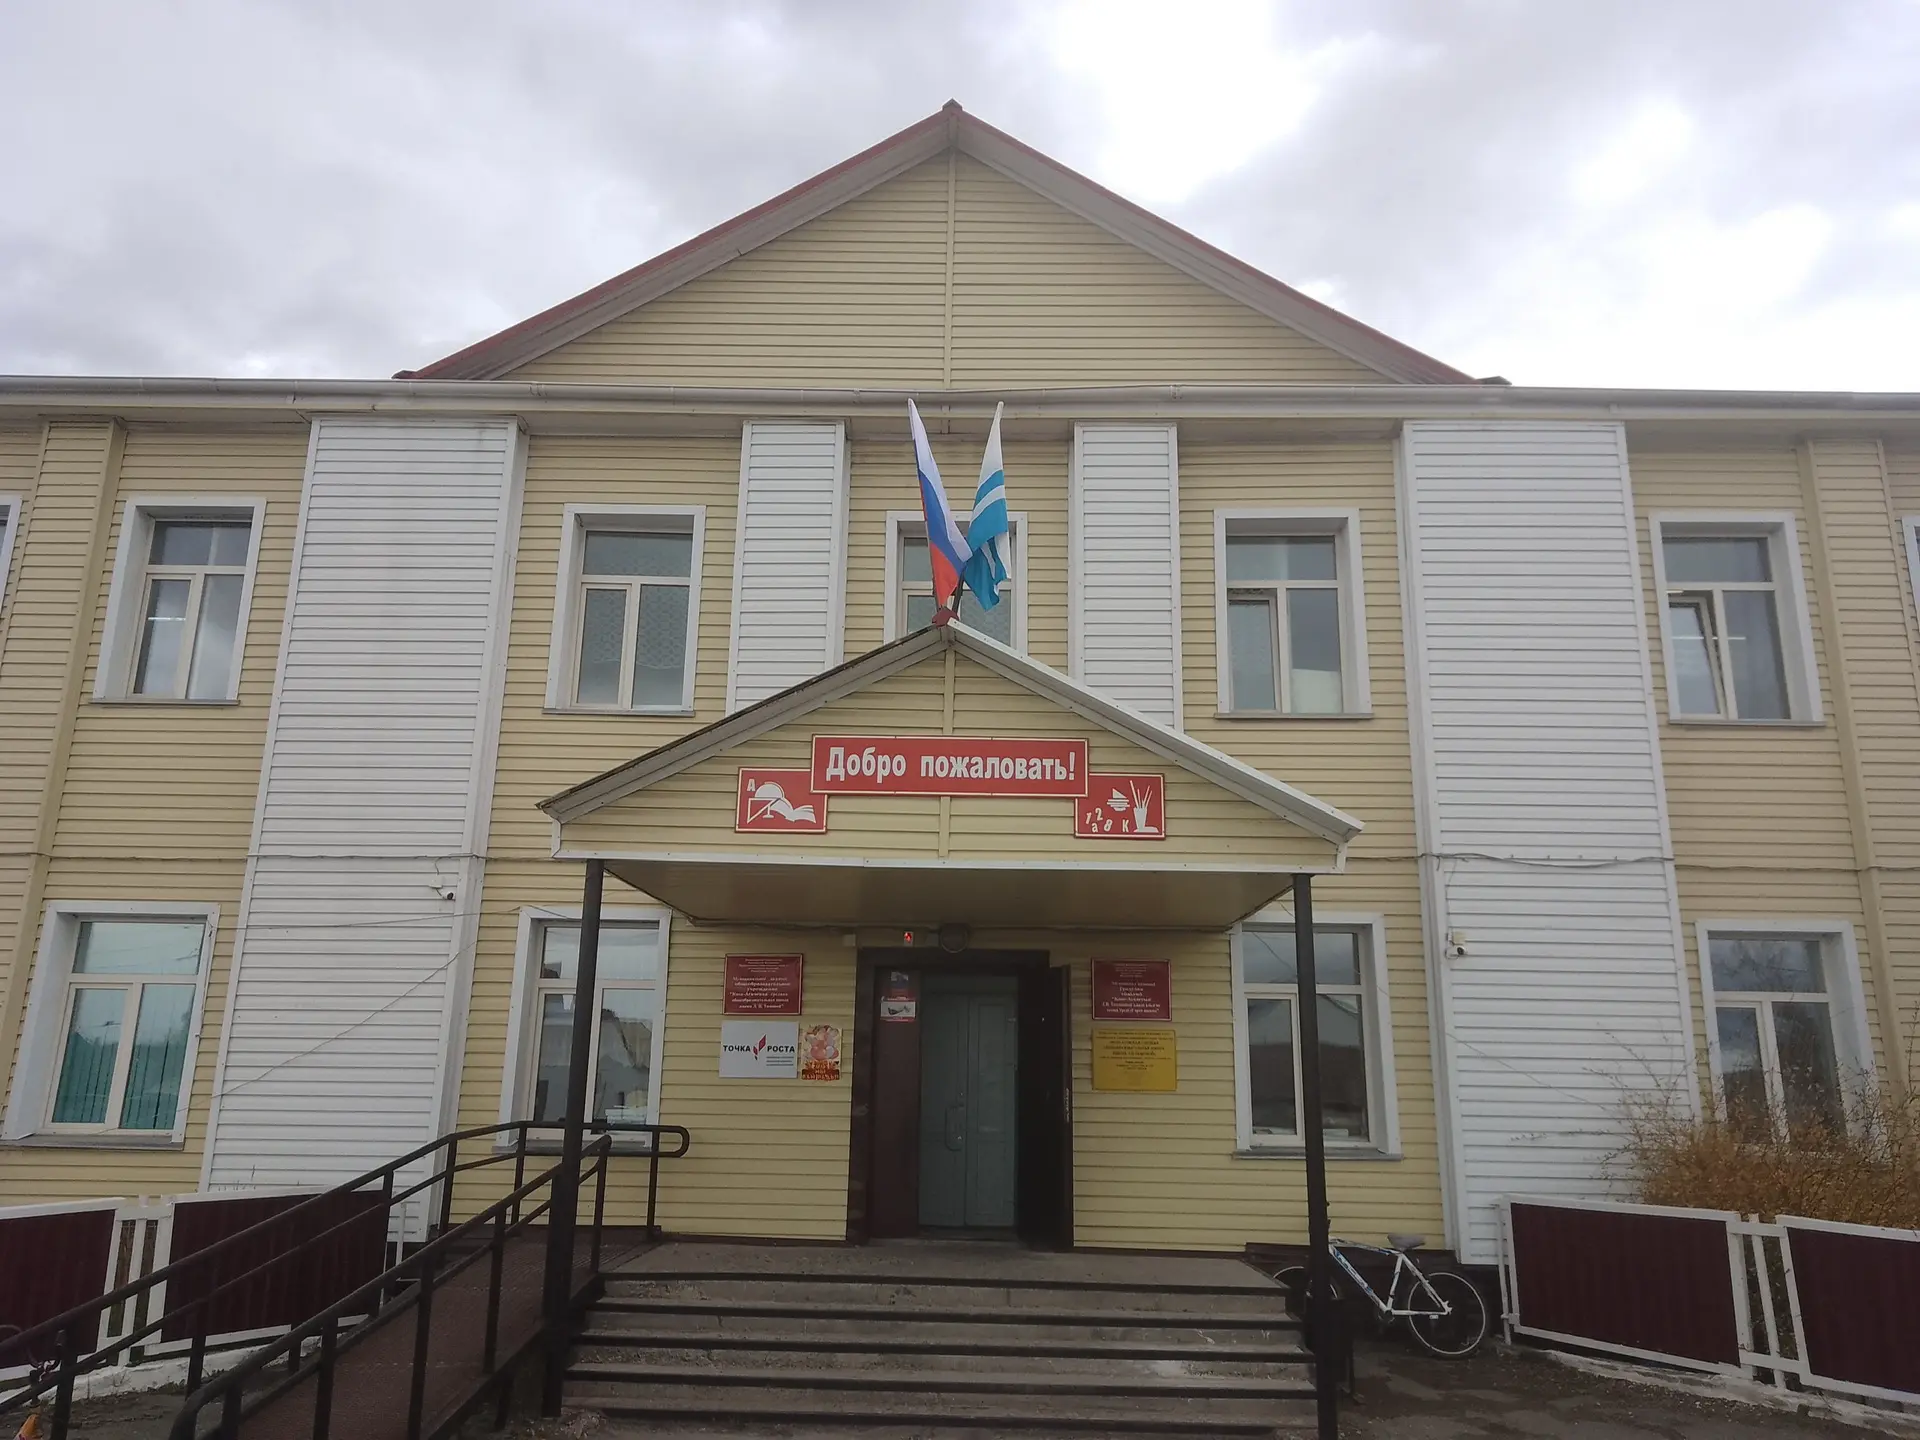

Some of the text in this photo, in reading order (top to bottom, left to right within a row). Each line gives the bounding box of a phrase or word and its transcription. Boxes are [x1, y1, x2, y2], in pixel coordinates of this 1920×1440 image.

[826, 746, 1076, 784] Добро пожаловать!
[767, 1045, 795, 1053] РОСТА
